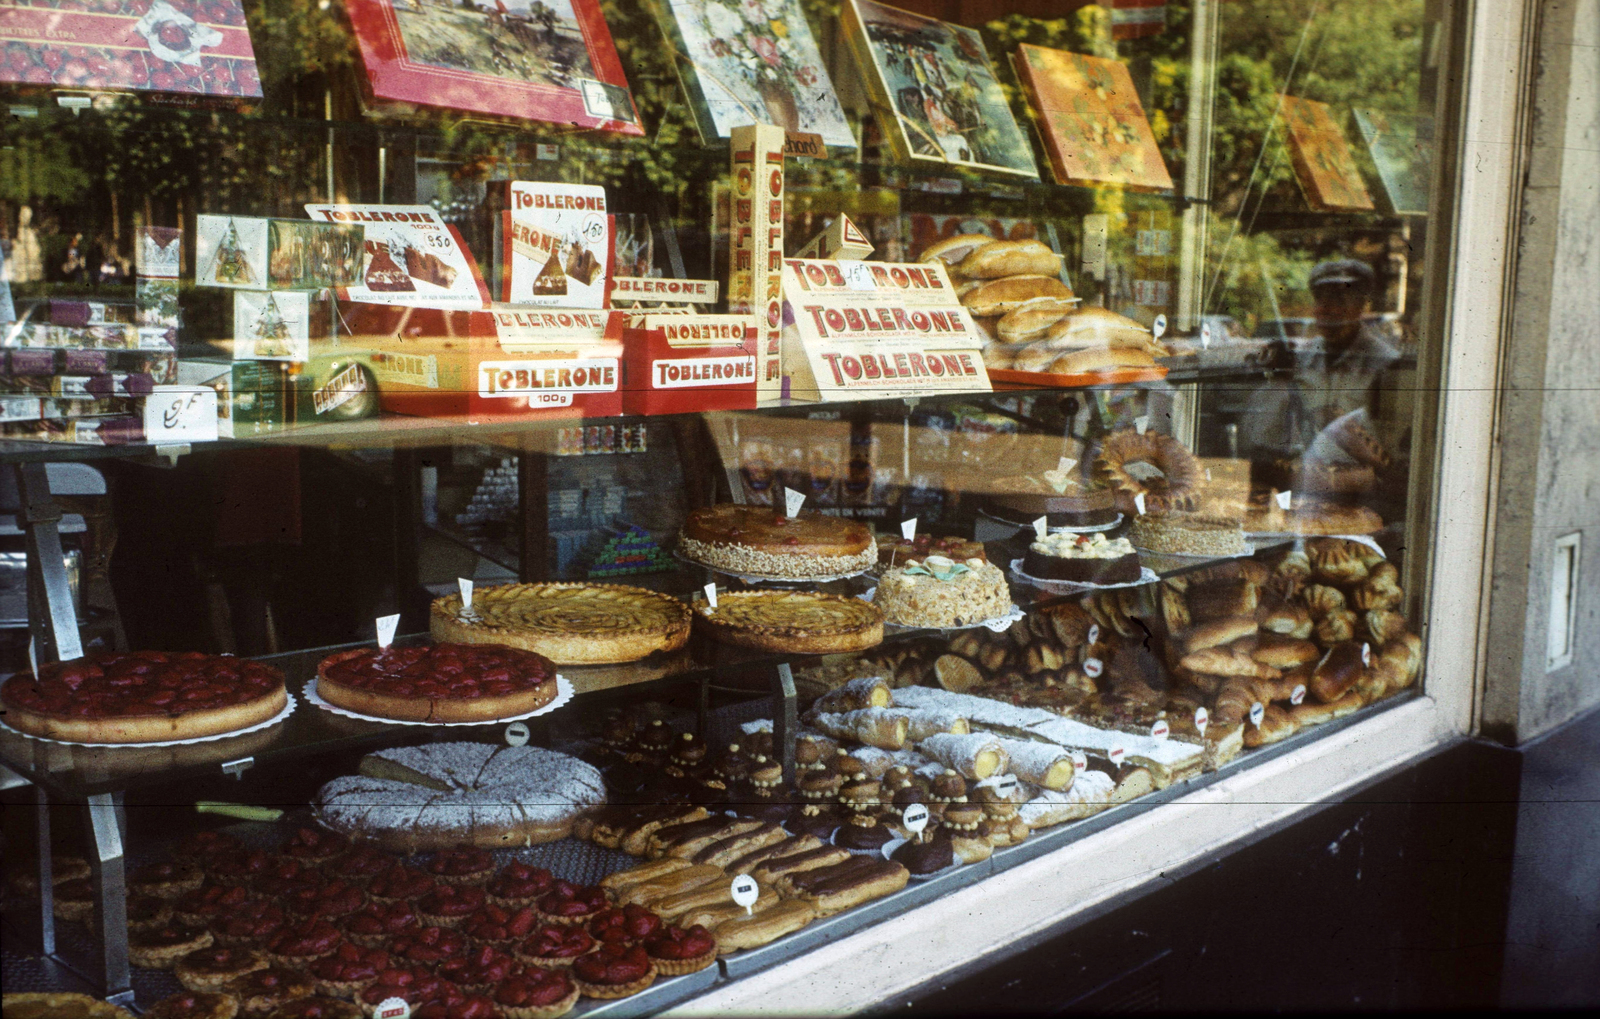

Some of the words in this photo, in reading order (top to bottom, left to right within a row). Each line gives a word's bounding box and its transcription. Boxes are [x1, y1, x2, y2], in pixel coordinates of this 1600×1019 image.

[512, 190, 605, 211] TOBLERONE
[317, 210, 435, 223] TOBLERONE
[765, 144, 784, 381] TOBLERONE
[784, 260, 944, 291] TOBRONE
[496, 313, 604, 328] BLERONE
[803, 305, 966, 337] TOBLERONE
[483, 367, 614, 394] TOBLERONE
[657, 362, 753, 385] TOBLERONE
[821, 353, 977, 386] TOBLERONE
